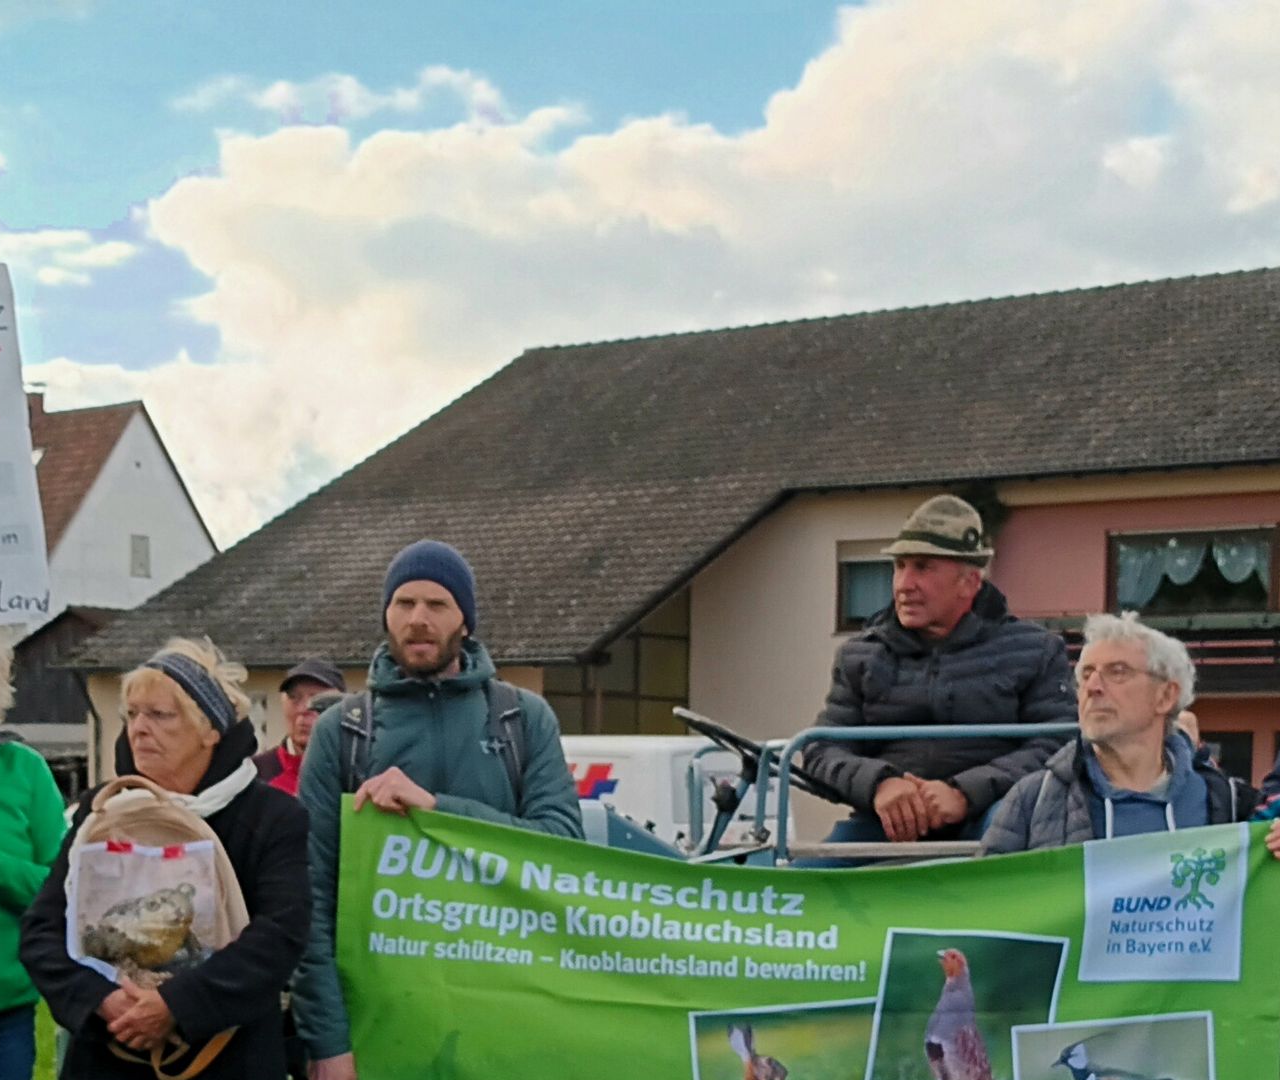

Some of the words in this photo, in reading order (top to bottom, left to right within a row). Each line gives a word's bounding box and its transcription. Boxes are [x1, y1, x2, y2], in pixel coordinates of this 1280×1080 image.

[378, 835, 508, 885] BUND
[521, 861, 805, 916] Naturschutz
[372, 888, 557, 939] Ortsgruppe
[566, 906, 838, 950] Knoblauchsland
[1113, 897, 1171, 913] BUND
[1110, 918, 1214, 933] Naturschutz
[369, 932, 429, 957] Natur
[434, 937, 533, 966] schützen
[560, 948, 738, 978] Knoblauchsland
[745, 958, 866, 982] bewahren!
[1106, 939, 1121, 954] in
[1126, 939, 1184, 956] Bayern
